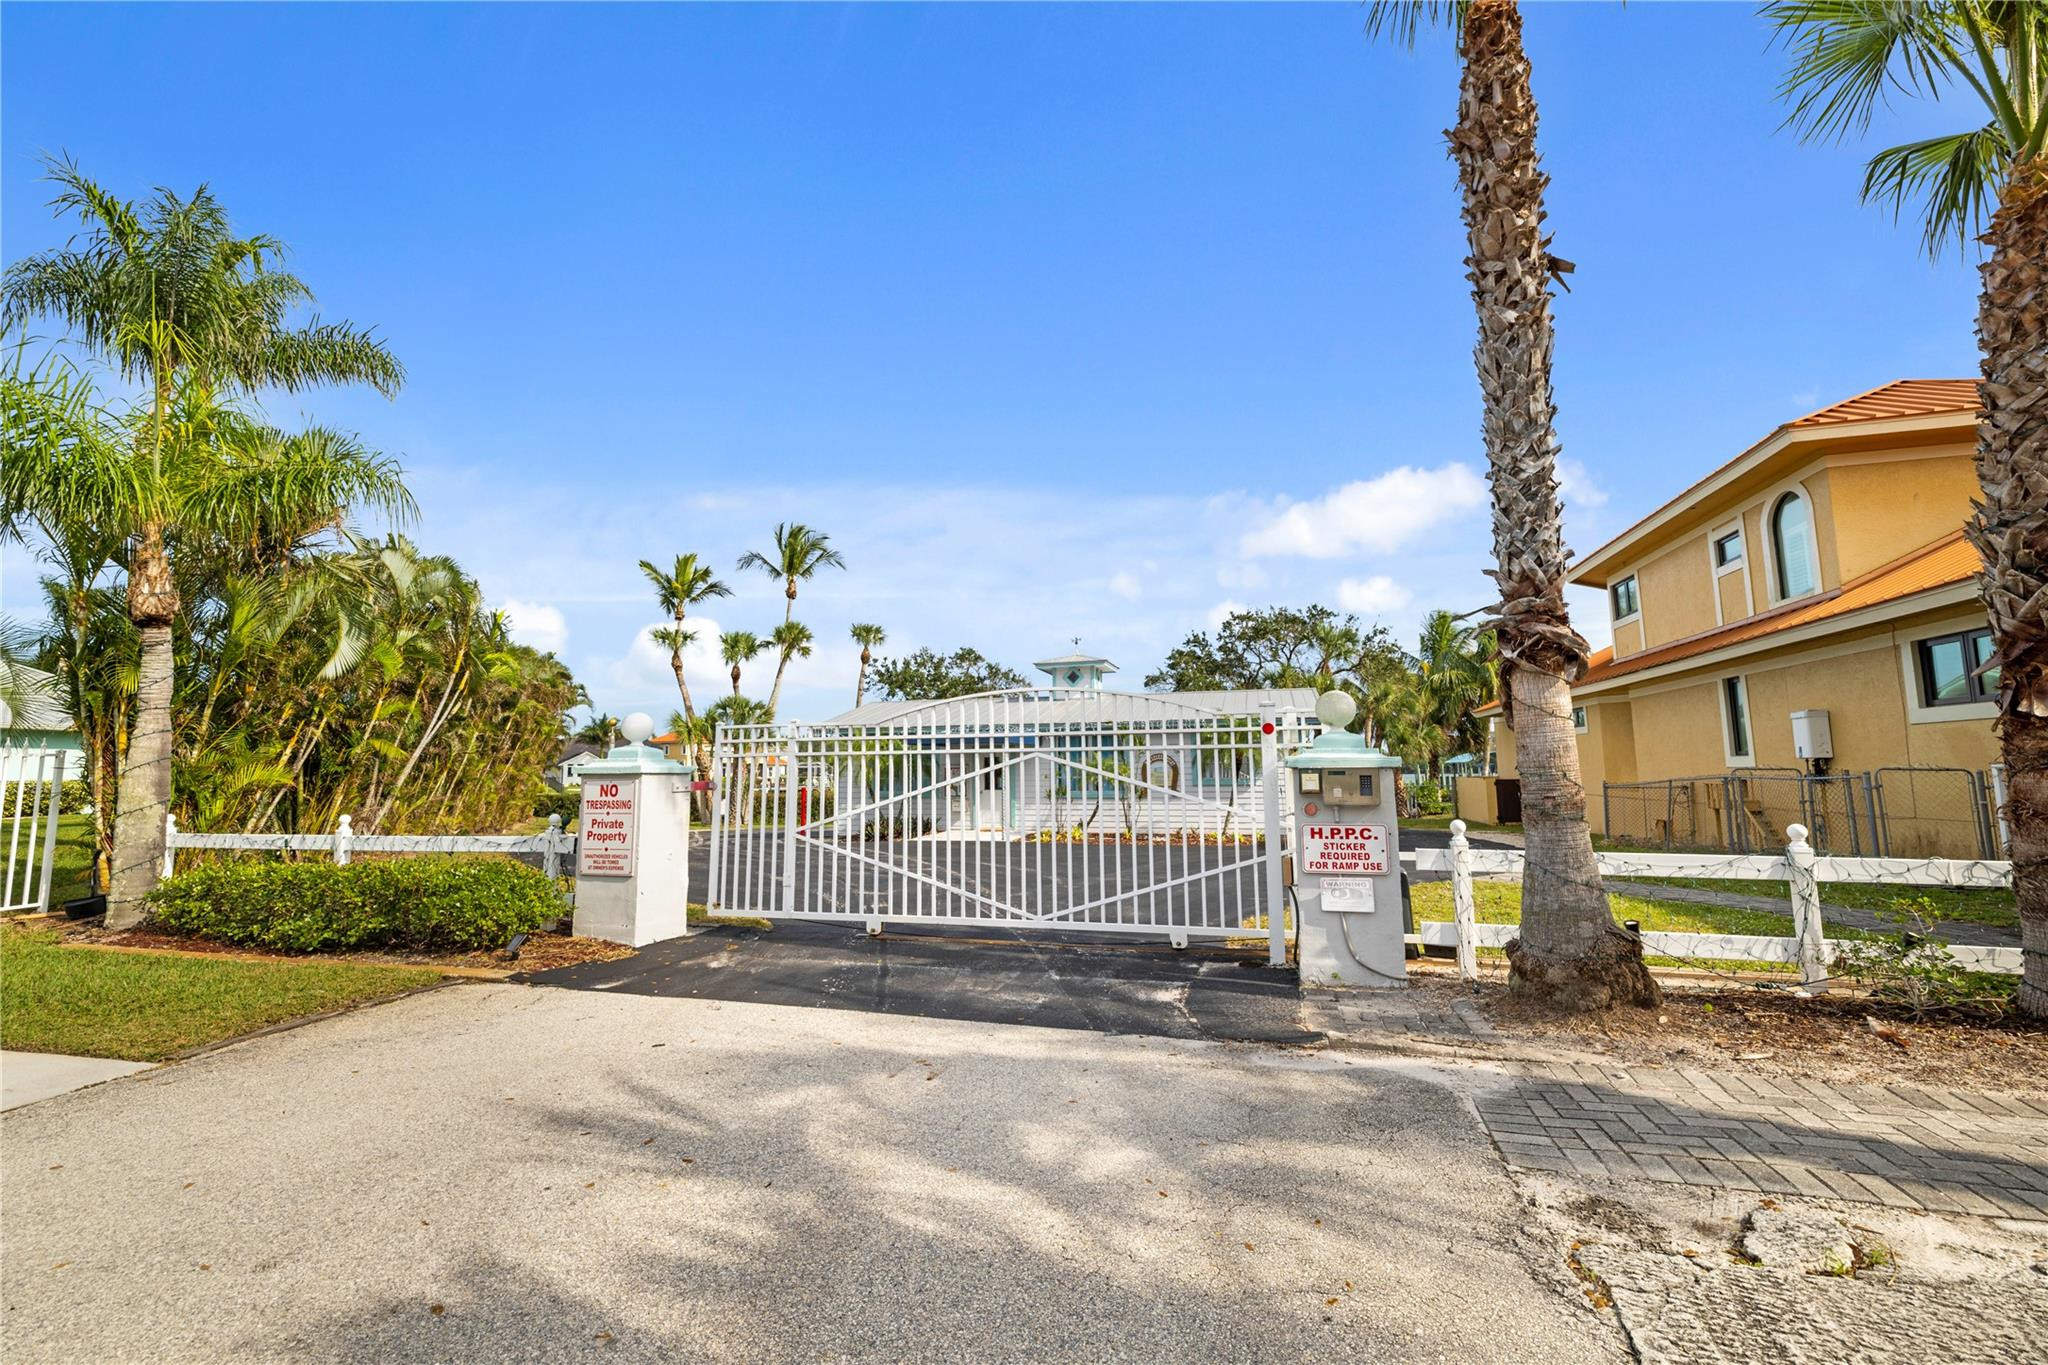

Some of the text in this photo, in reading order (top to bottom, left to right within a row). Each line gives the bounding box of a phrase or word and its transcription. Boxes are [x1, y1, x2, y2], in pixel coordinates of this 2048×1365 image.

[600, 784, 619, 798] NO
[586, 800, 632, 810] TRESPASSING
[592, 819, 624, 829] Private
[587, 831, 627, 844] Property
[1310, 828, 1378, 840] H.P.P.C.
[1324, 842, 1366, 850] STICKER
[1320, 852, 1370, 860] REQUIRED
[1310, 862, 1382, 870] FOR RAMP USE
